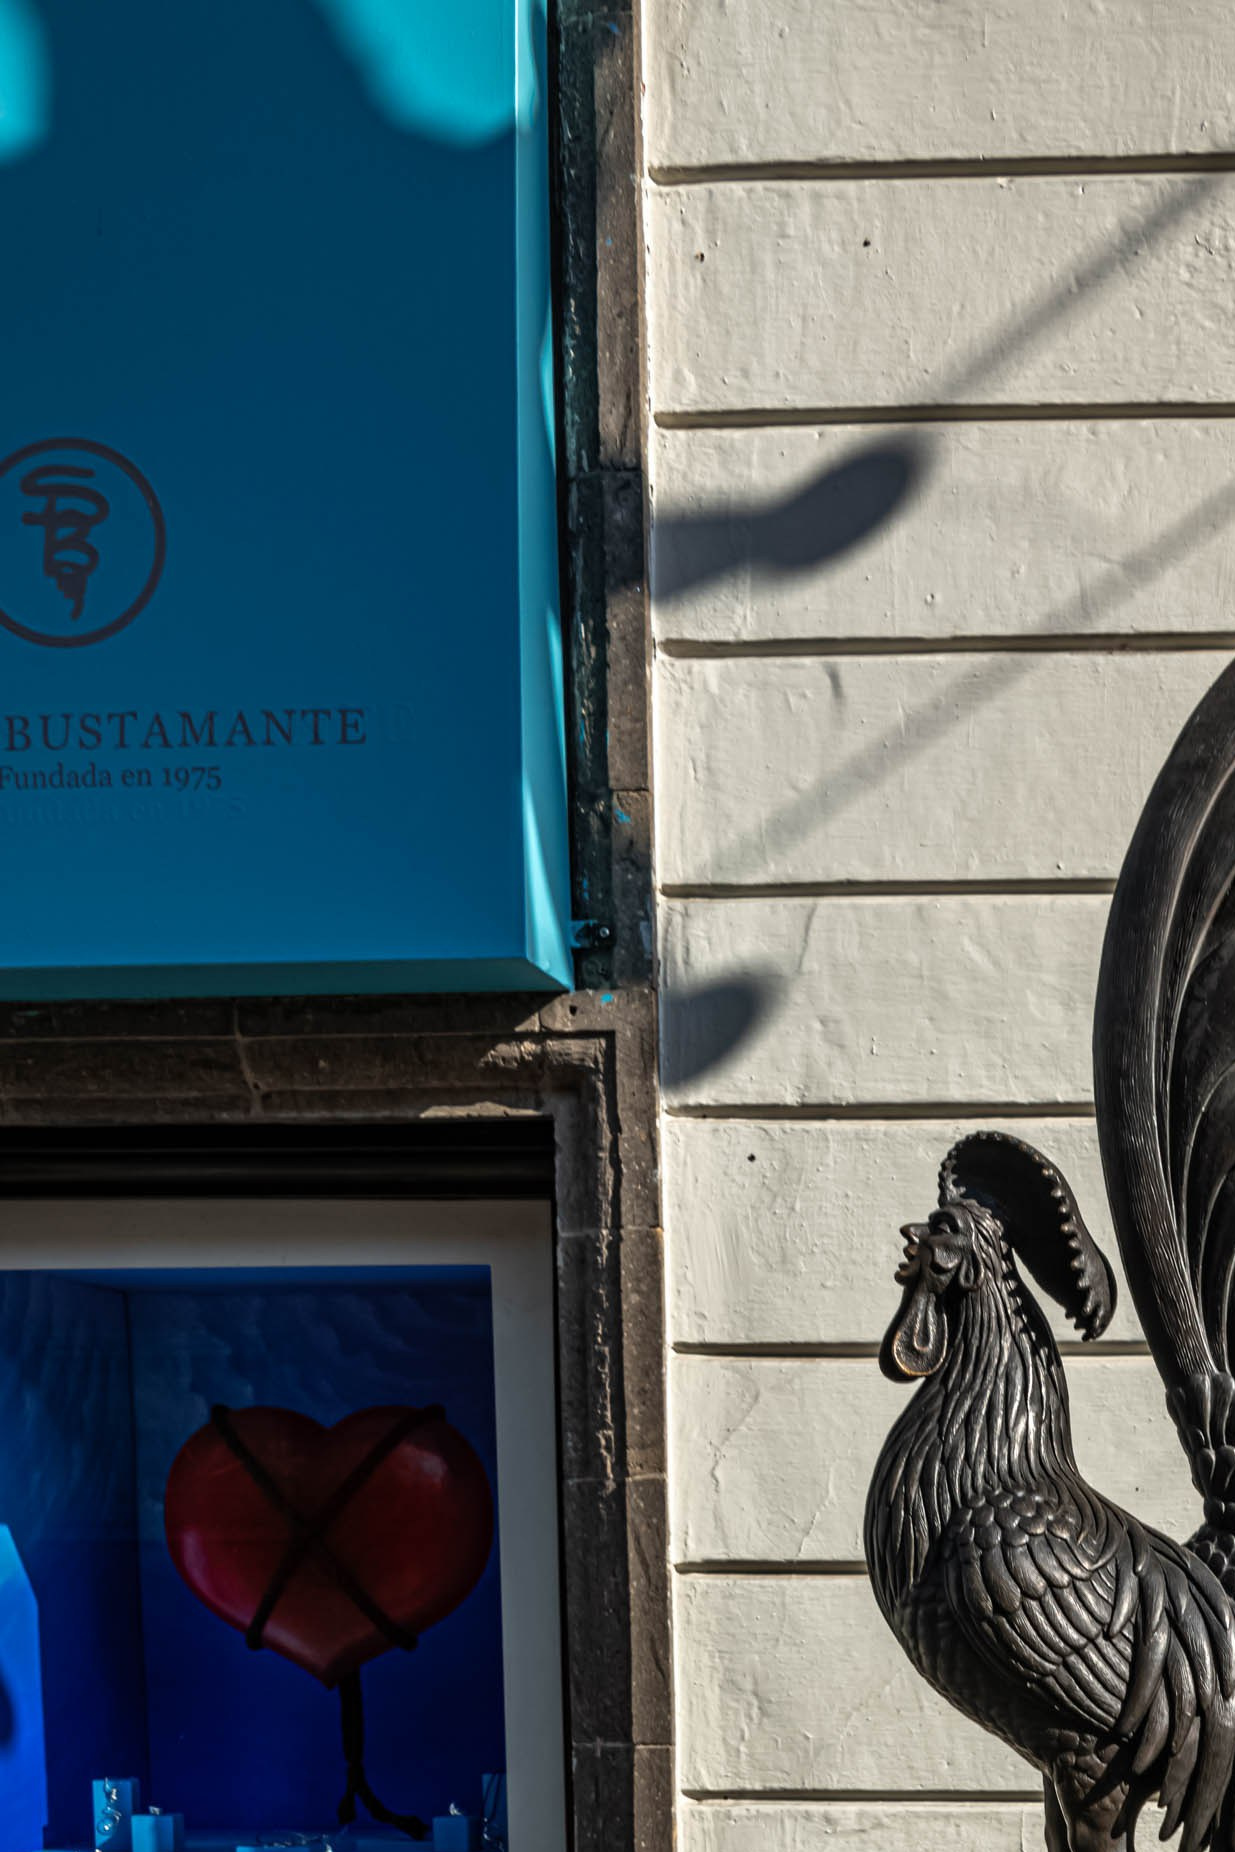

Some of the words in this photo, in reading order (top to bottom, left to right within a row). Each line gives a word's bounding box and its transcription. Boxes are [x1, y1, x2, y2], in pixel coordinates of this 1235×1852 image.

[4, 707, 367, 752] BUSTAMANTE
[0, 761, 112, 791] Fundada
[121, 768, 153, 788] en
[161, 764, 223, 792] 1975
